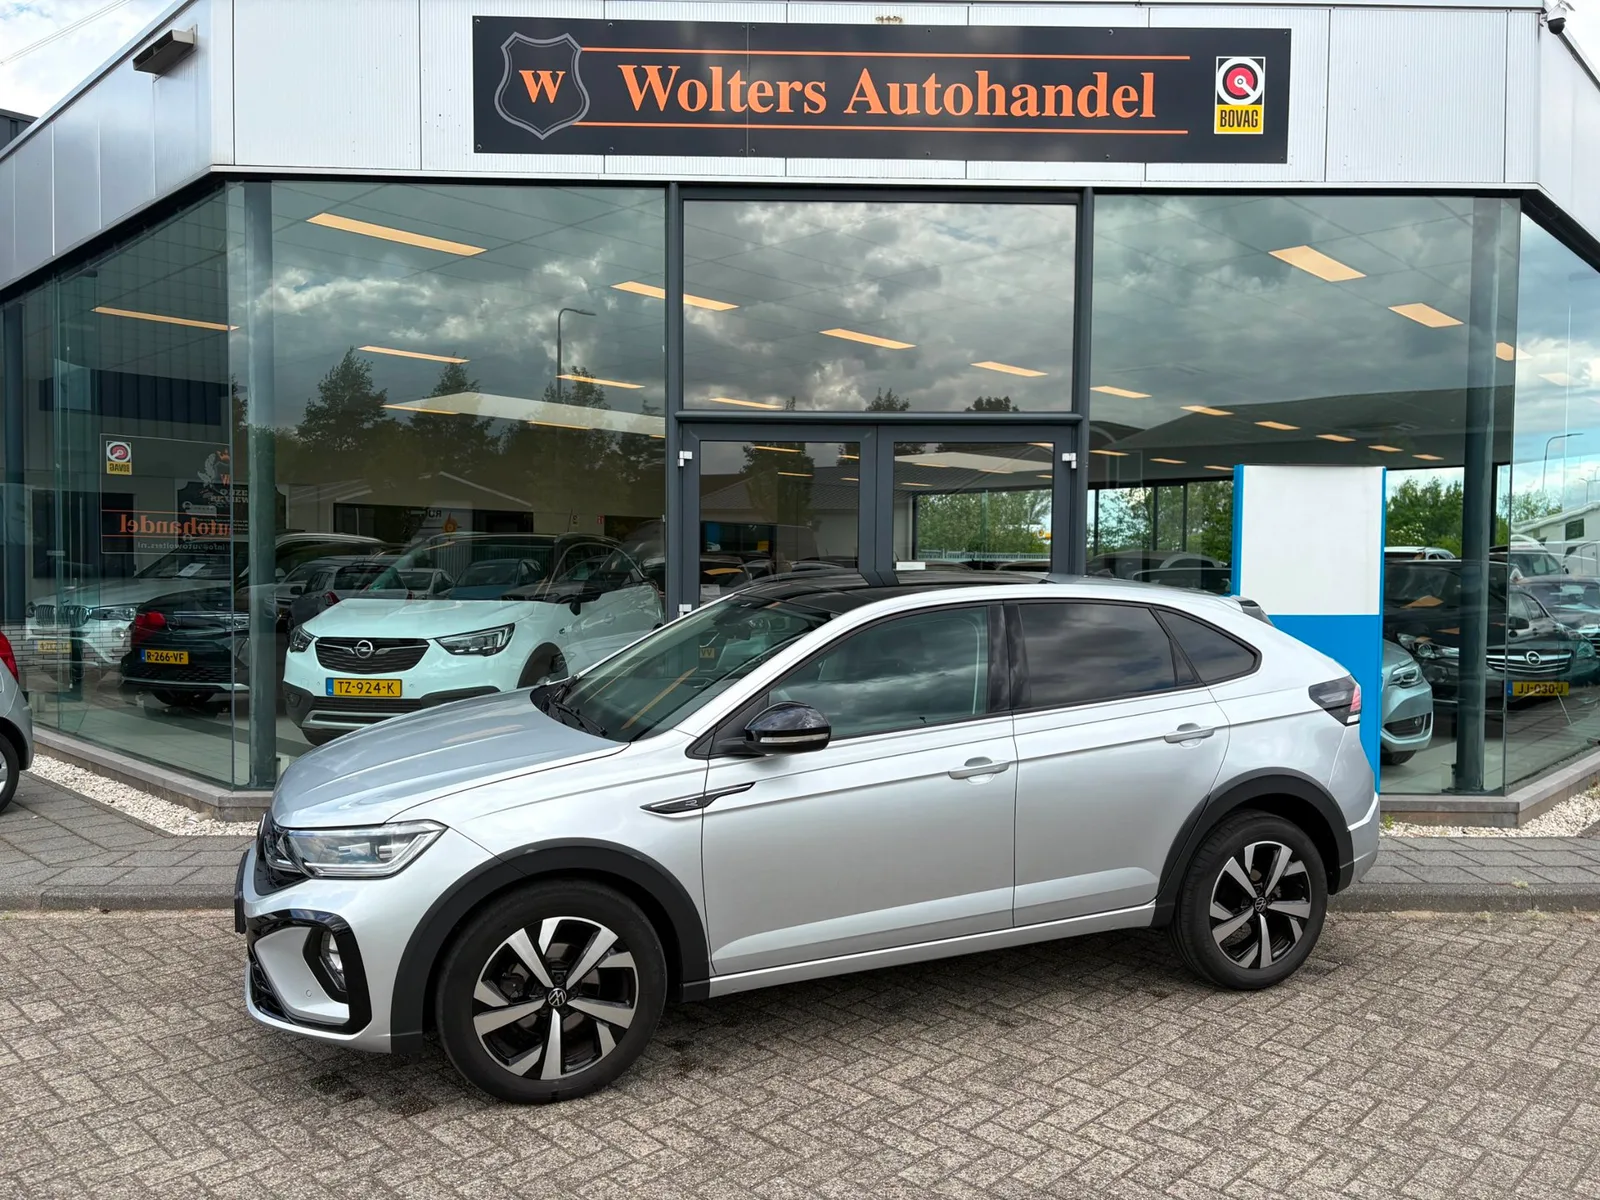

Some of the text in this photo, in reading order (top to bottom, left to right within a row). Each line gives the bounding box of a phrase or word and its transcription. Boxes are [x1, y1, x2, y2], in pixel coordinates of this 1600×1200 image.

[518, 69, 566, 104] W
[617, 64, 1156, 119] Wolters Autohandel
[1218, 108, 1259, 129] BOVAG
[146, 651, 185, 663] R-266-VF
[337, 680, 395, 695] TZ-924-K
[1518, 682, 1564, 694] JJ-030-J
